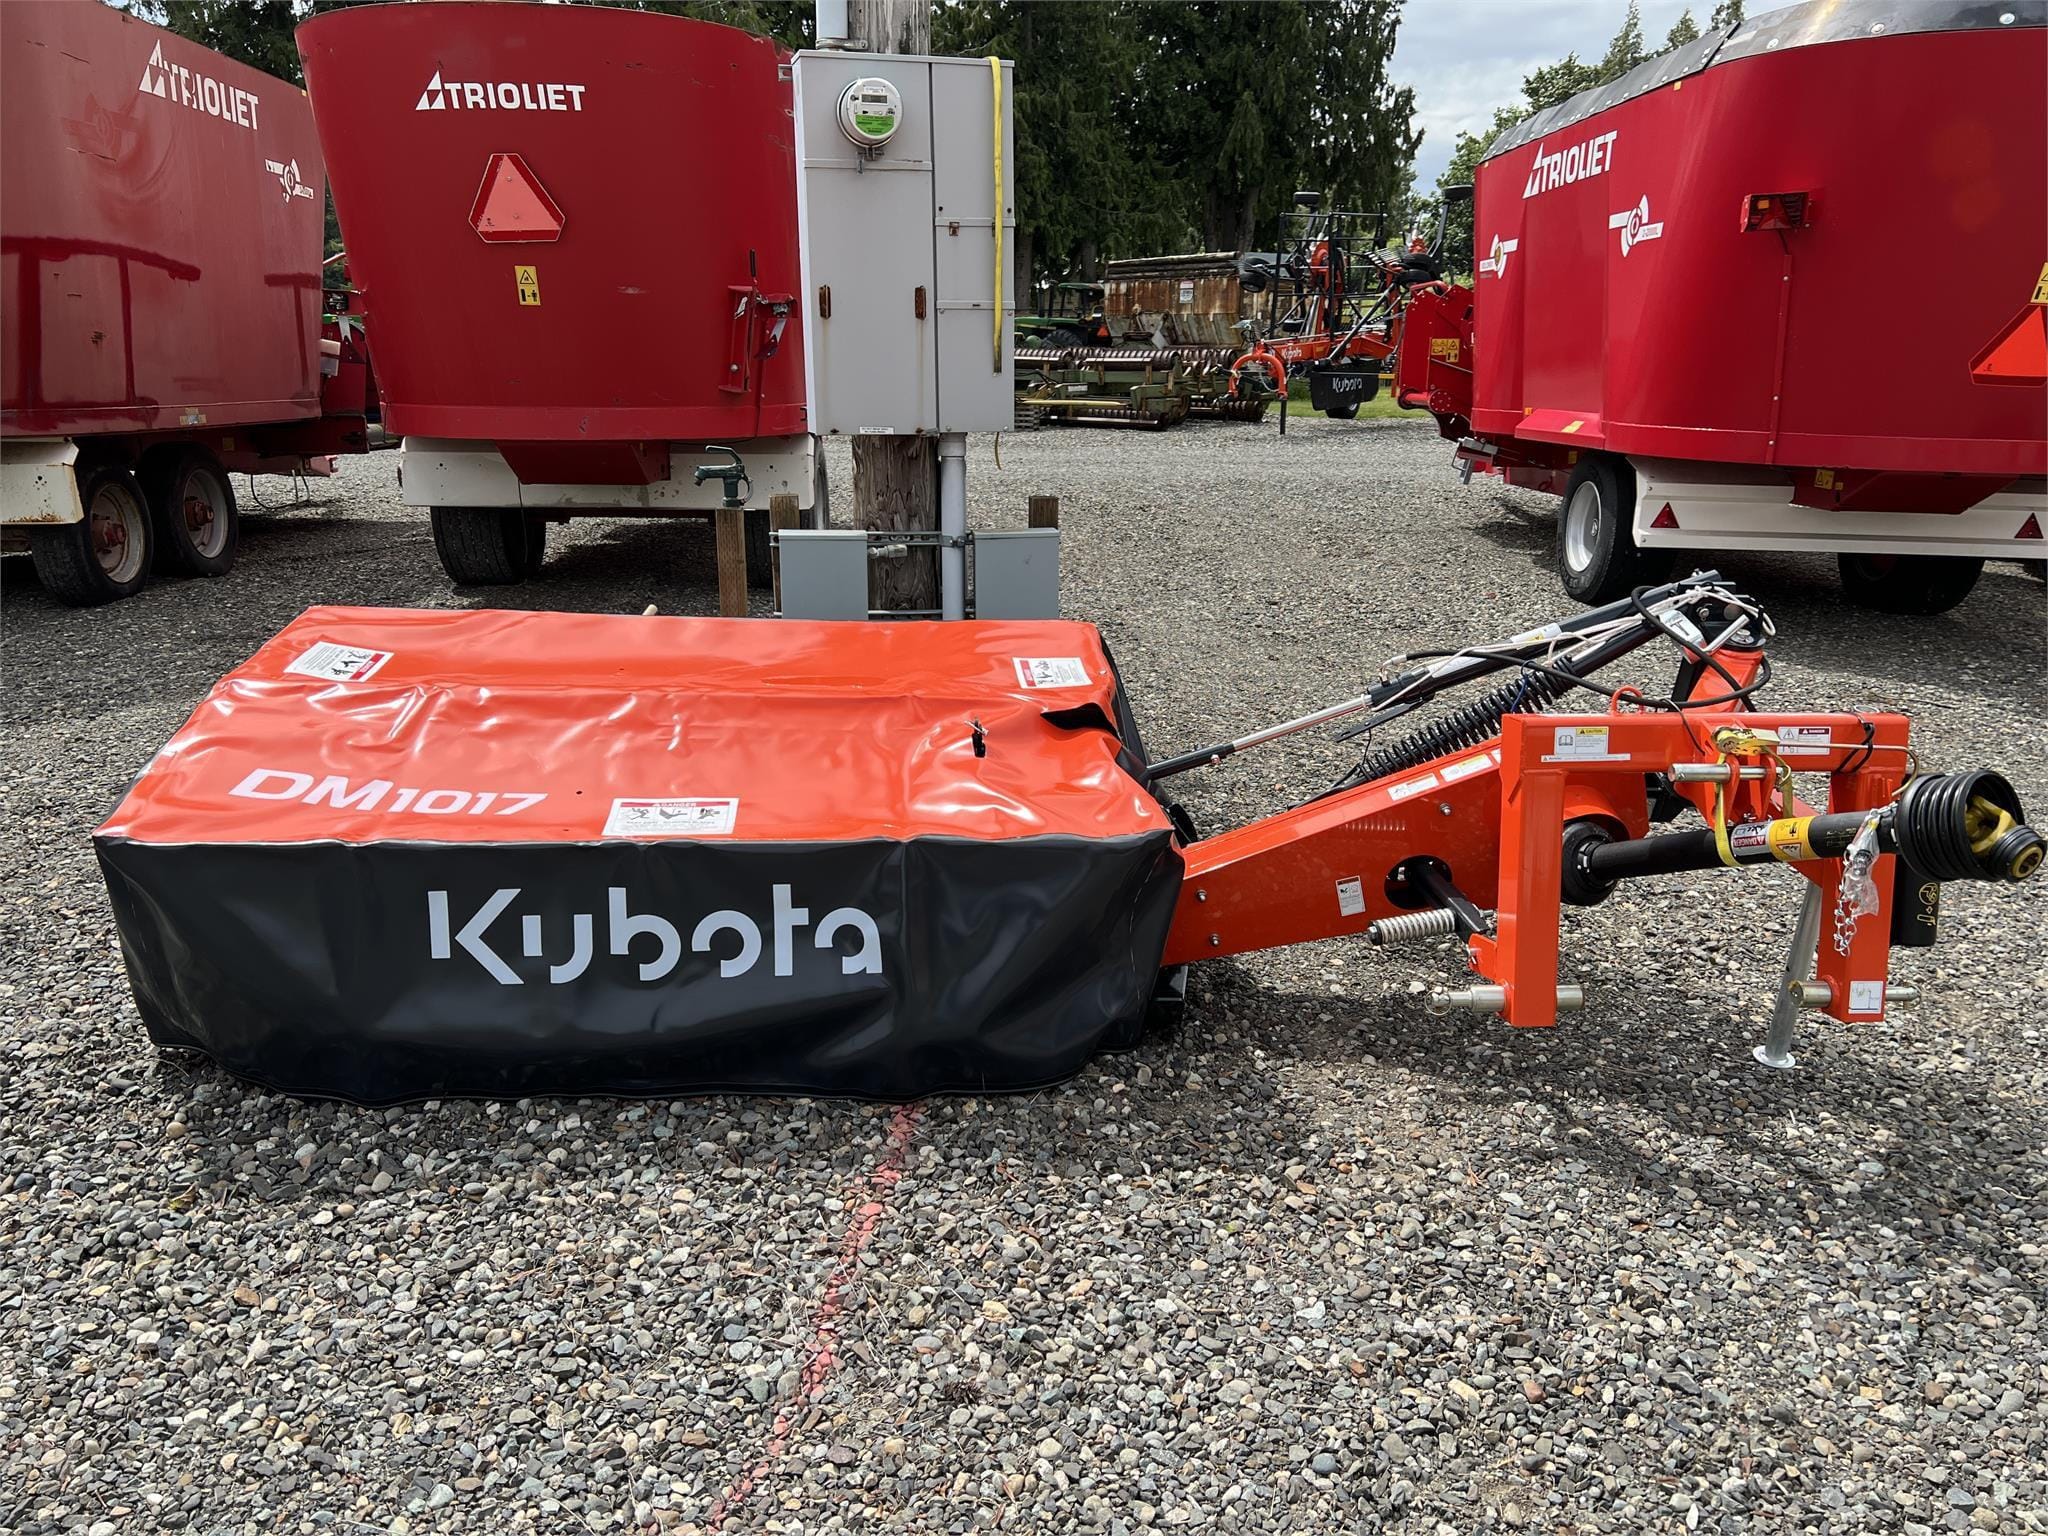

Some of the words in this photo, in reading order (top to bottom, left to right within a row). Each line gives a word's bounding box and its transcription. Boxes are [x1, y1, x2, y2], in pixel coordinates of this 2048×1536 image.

[444, 82, 586, 111] TRIOLIET
[1540, 130, 1618, 193] TRIOLIET
[1332, 378, 1363, 393] Kubota
[228, 768, 548, 815] DM1017
[1733, 836, 1758, 847] DANGER
[428, 884, 883, 985] Kubota
